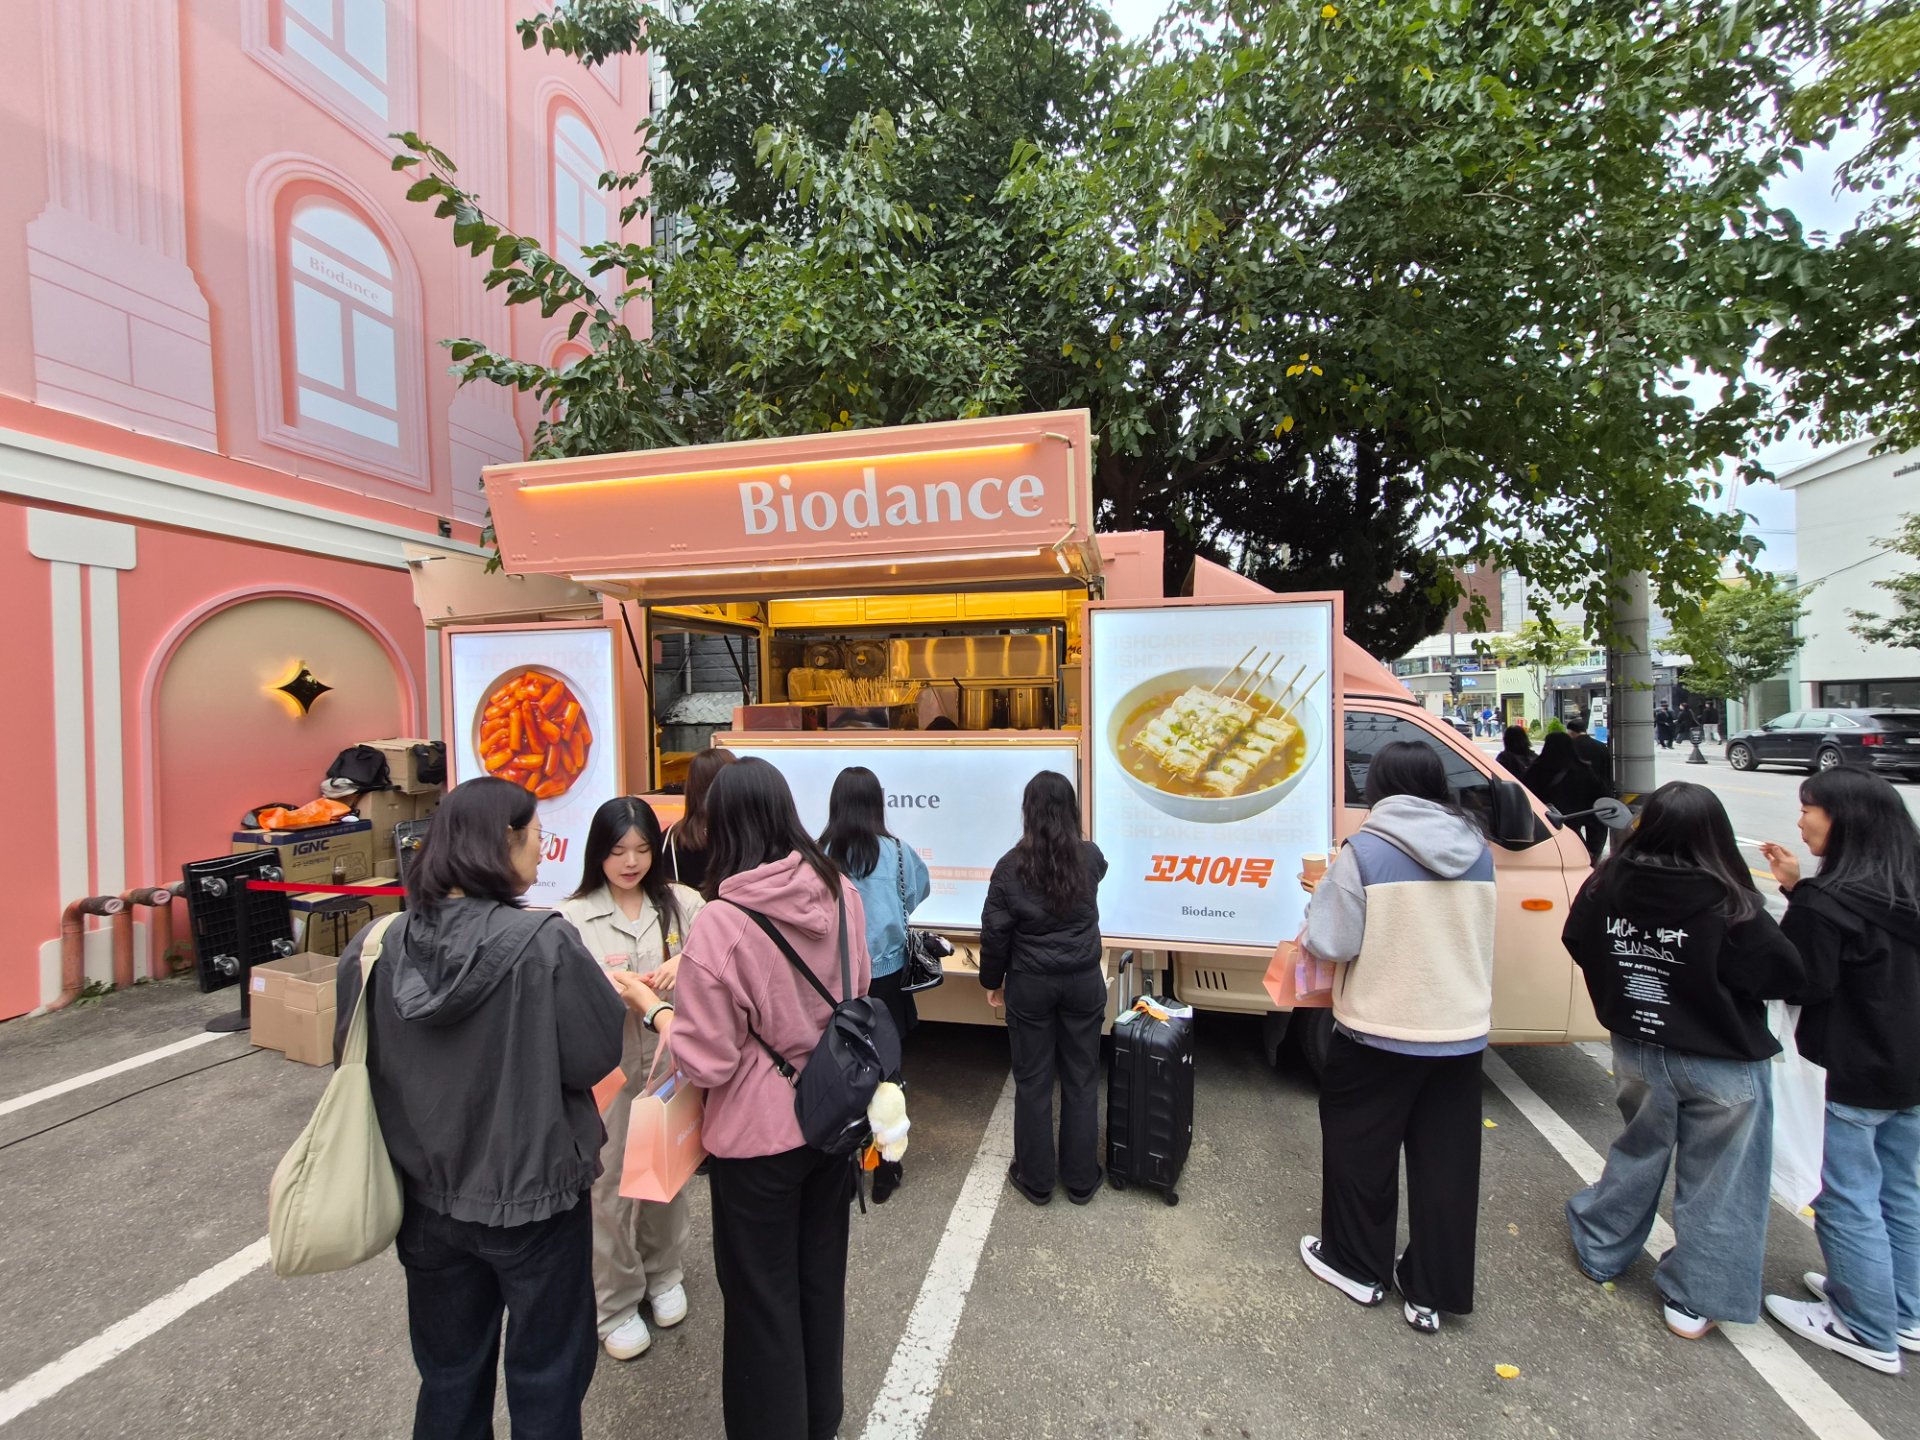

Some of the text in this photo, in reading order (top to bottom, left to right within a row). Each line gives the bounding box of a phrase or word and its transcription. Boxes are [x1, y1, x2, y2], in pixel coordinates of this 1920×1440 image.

[309, 256, 379, 302] Biodance
[738, 467, 1044, 535] Biodance
[881, 788, 941, 809] ance
[293, 840, 330, 856] IGNC
[1144, 854, 1275, 888] 꼬치어묵
[1181, 905, 1236, 919] Biodance
[1634, 964, 1657, 972] AFTER
